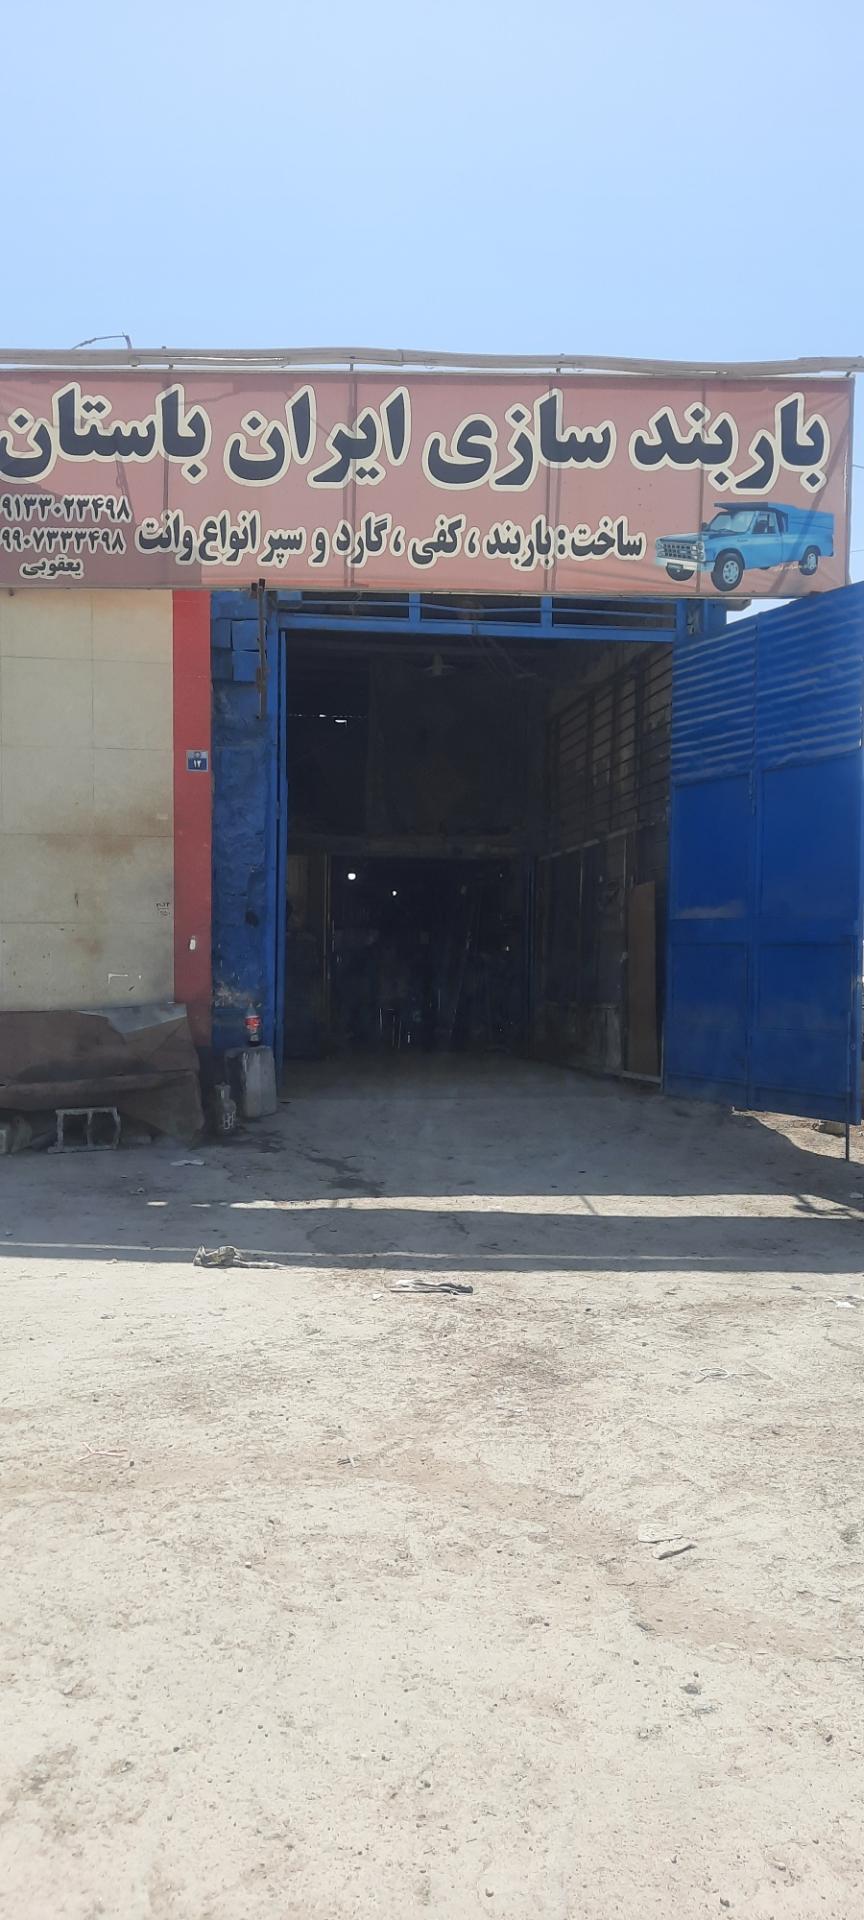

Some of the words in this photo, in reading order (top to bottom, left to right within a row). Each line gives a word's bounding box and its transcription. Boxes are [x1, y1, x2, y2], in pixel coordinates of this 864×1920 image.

[0, 386, 208, 479] باستان
[227, 389, 407, 485] ایران
[426, 393, 613, 486] سازی
[137, 514, 194, 563] وانت
[198, 514, 258, 563] انواع
[260, 531, 303, 564] سپر
[312, 531, 326, 564] و
[336, 515, 389, 564] گارد
[412, 518, 463, 565] کفی
[21, 556, 82, 577] یعقوبی
